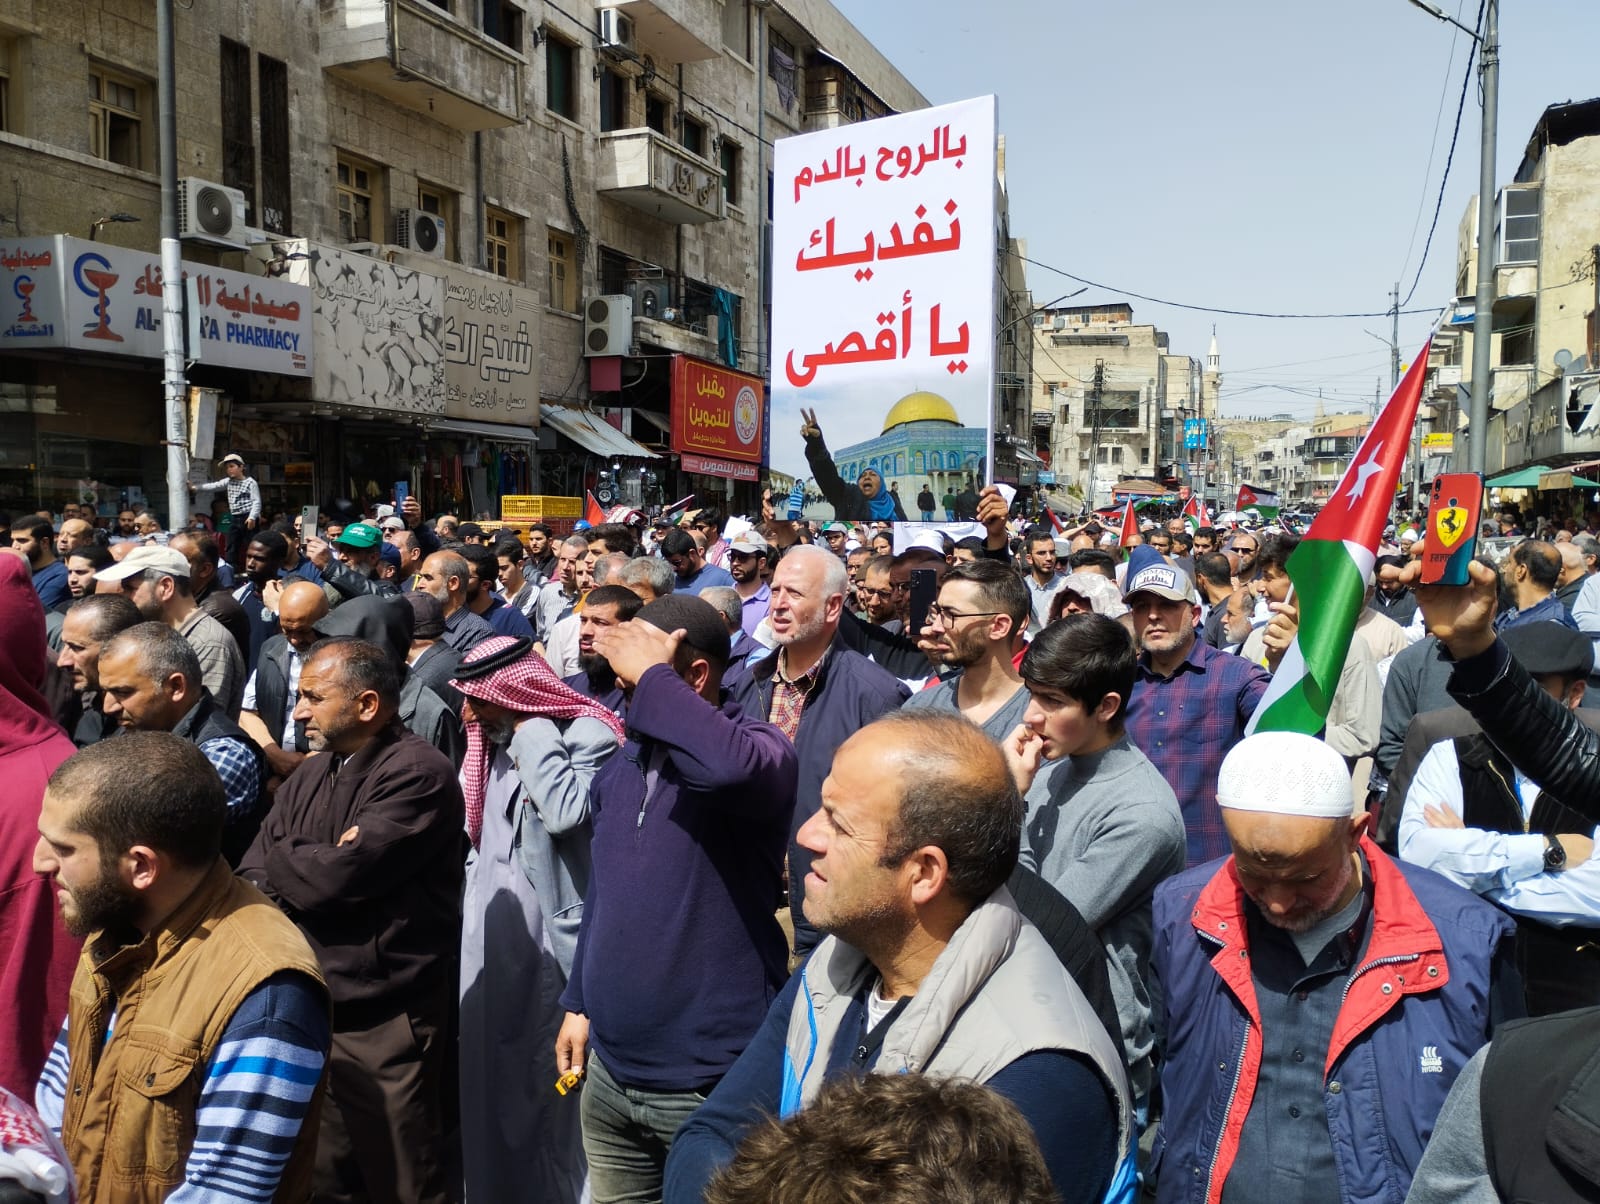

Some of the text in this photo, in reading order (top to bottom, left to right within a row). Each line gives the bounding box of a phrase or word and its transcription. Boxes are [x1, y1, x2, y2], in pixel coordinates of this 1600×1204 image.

[794, 124, 967, 204] بالروح بالدم
[796, 198, 961, 282] نفديك
[216, 278, 300, 324] صيدلية
[226, 321, 300, 352] PHARMACY
[480, 320, 533, 383] شيخ
[785, 289, 969, 387] يا أقصى
[696, 374, 725, 399] مقبل
[689, 403, 730, 428] للتموين
[700, 457, 733, 473] للتموين
[734, 464, 756, 476] مقبل
[1421, 1065, 1443, 1073] HYDRO
